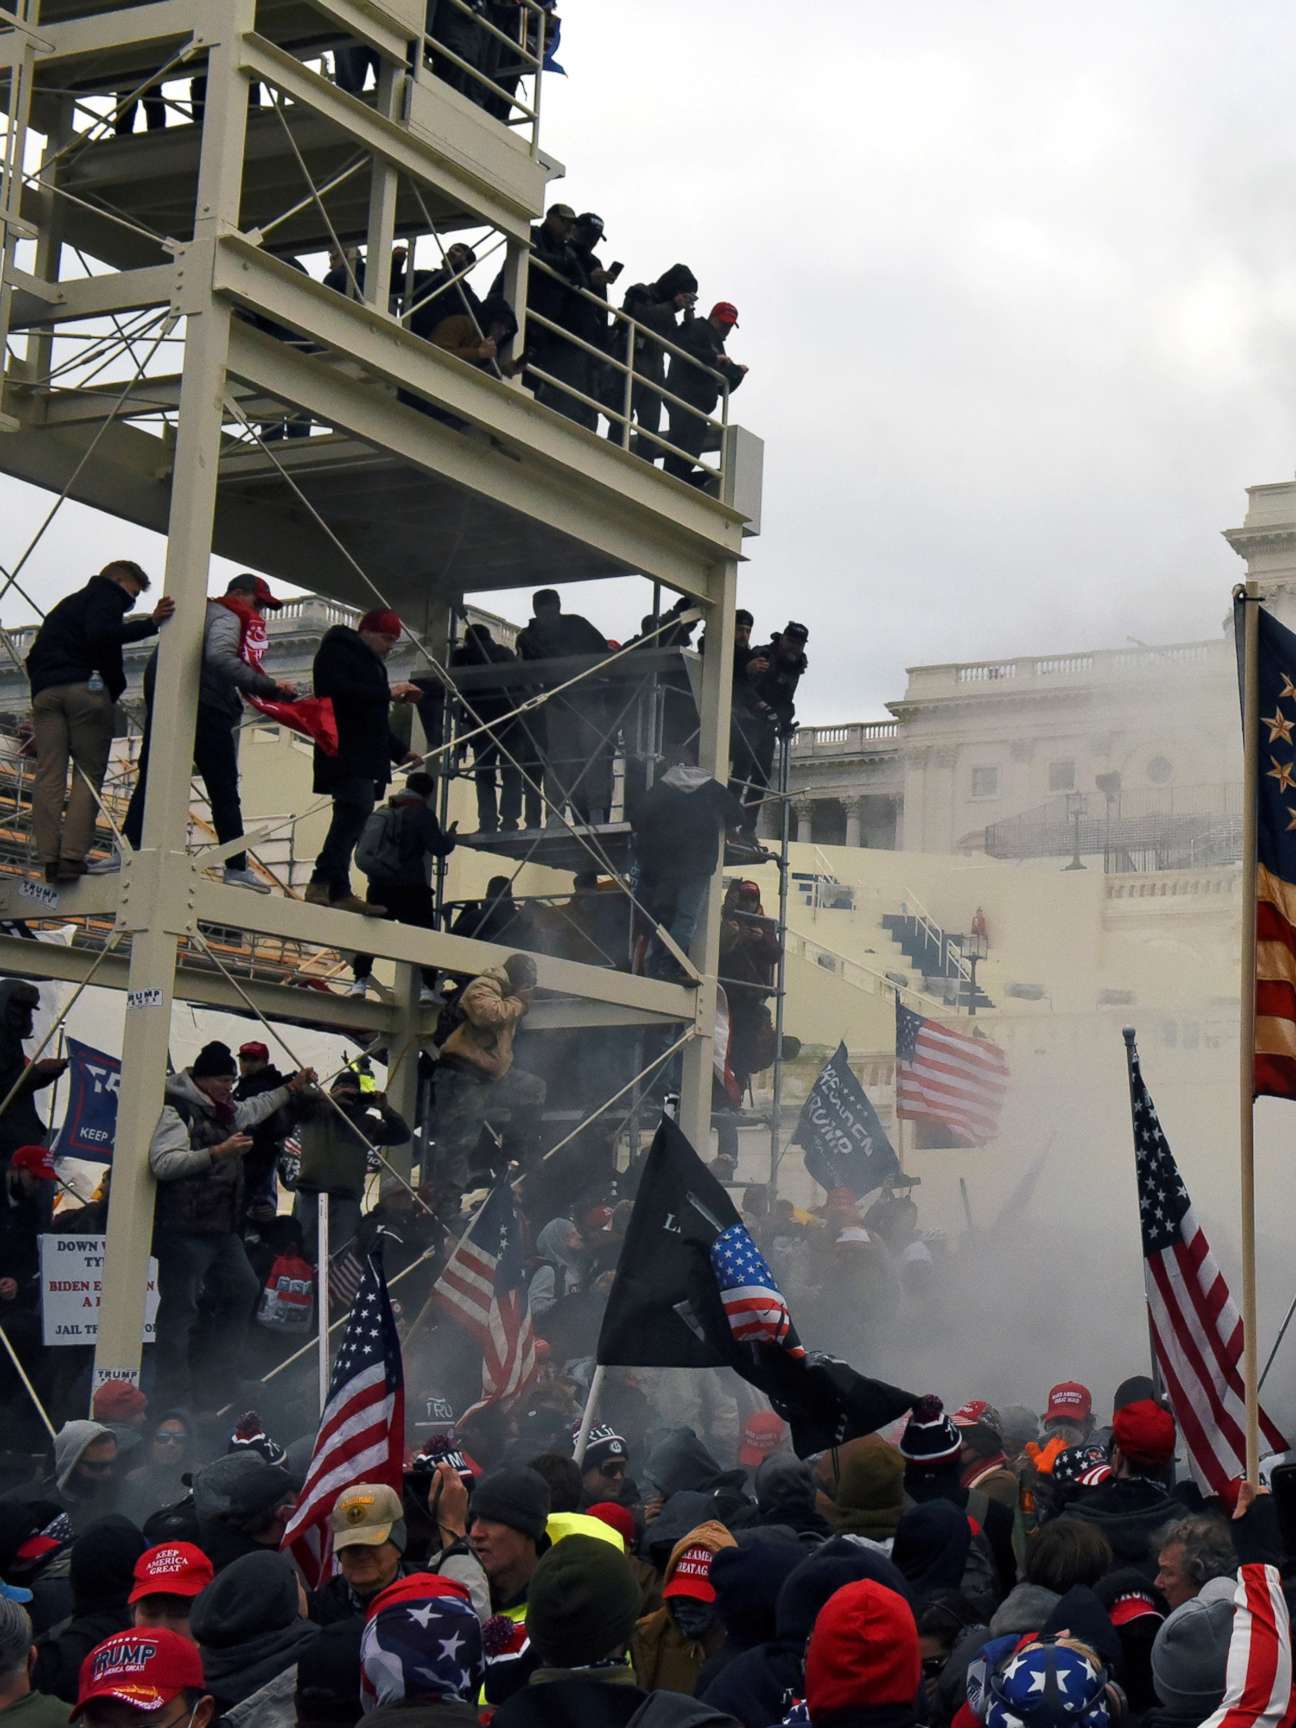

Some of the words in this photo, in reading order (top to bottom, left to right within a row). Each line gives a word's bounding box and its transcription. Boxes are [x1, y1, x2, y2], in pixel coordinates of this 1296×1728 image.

[80, 1126, 109, 1142] KEEP
[57, 1241, 98, 1251] DOWN
[49, 1281, 90, 1292] BIDEN
[56, 1325, 82, 1335] JAIL
[155, 1549, 180, 1560] KEEP
[146, 1556, 188, 1571] AMERICA
[150, 1564, 182, 1575] GREAT
